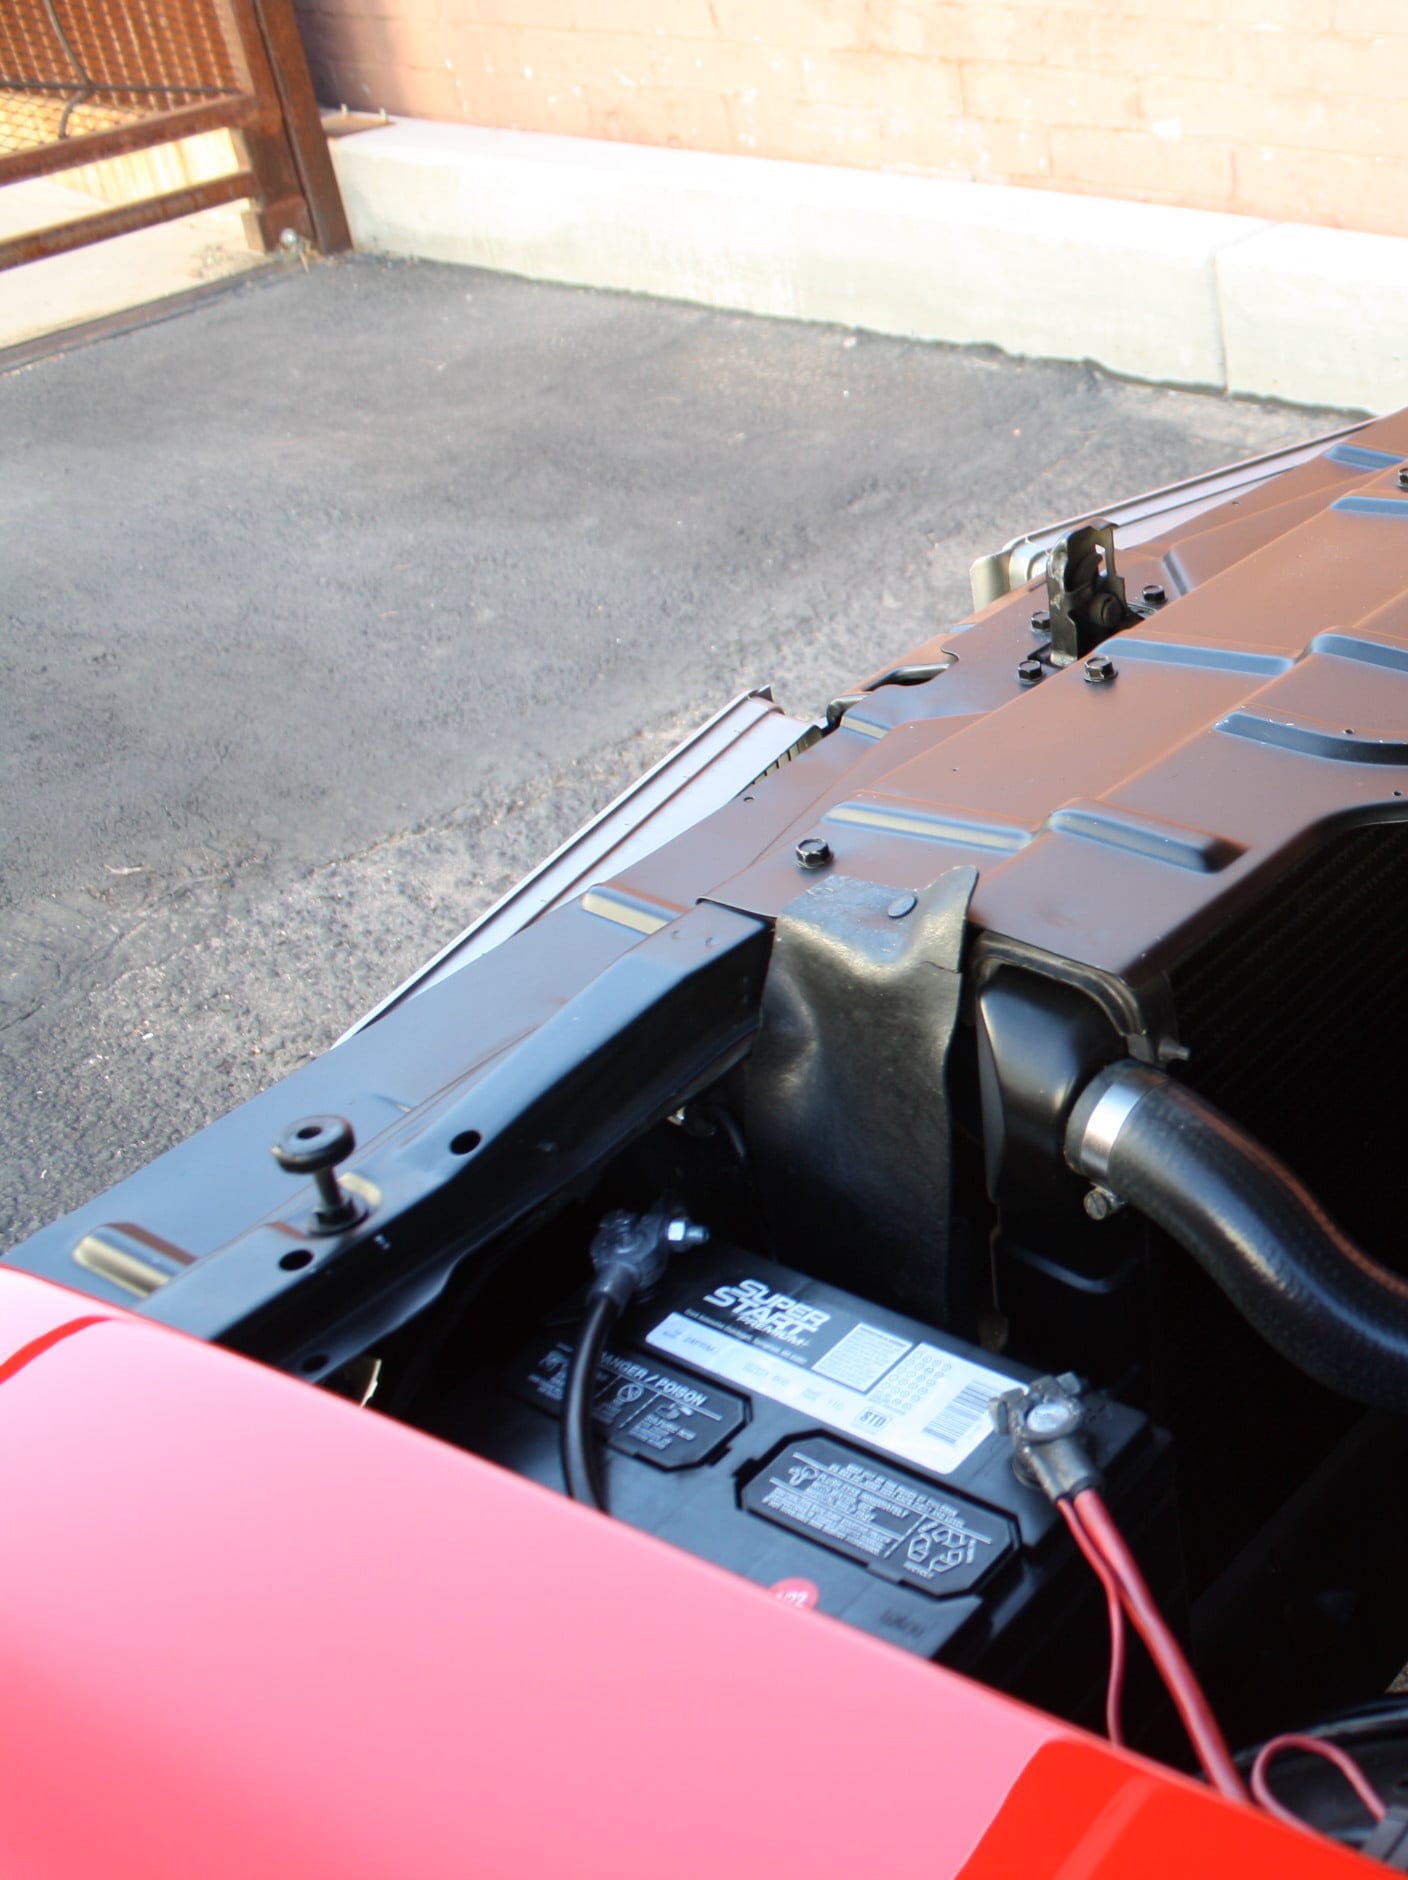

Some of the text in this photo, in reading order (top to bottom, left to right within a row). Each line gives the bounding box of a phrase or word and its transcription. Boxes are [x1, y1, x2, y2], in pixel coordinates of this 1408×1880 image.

[703, 1286, 819, 1335] START
[728, 1279, 831, 1326] SUPER
[735, 1314, 806, 1346] PREMIUM
[600, 1351, 650, 1380] ANGER
[655, 1377, 708, 1406] POISON
[859, 1410, 887, 1429] STD
